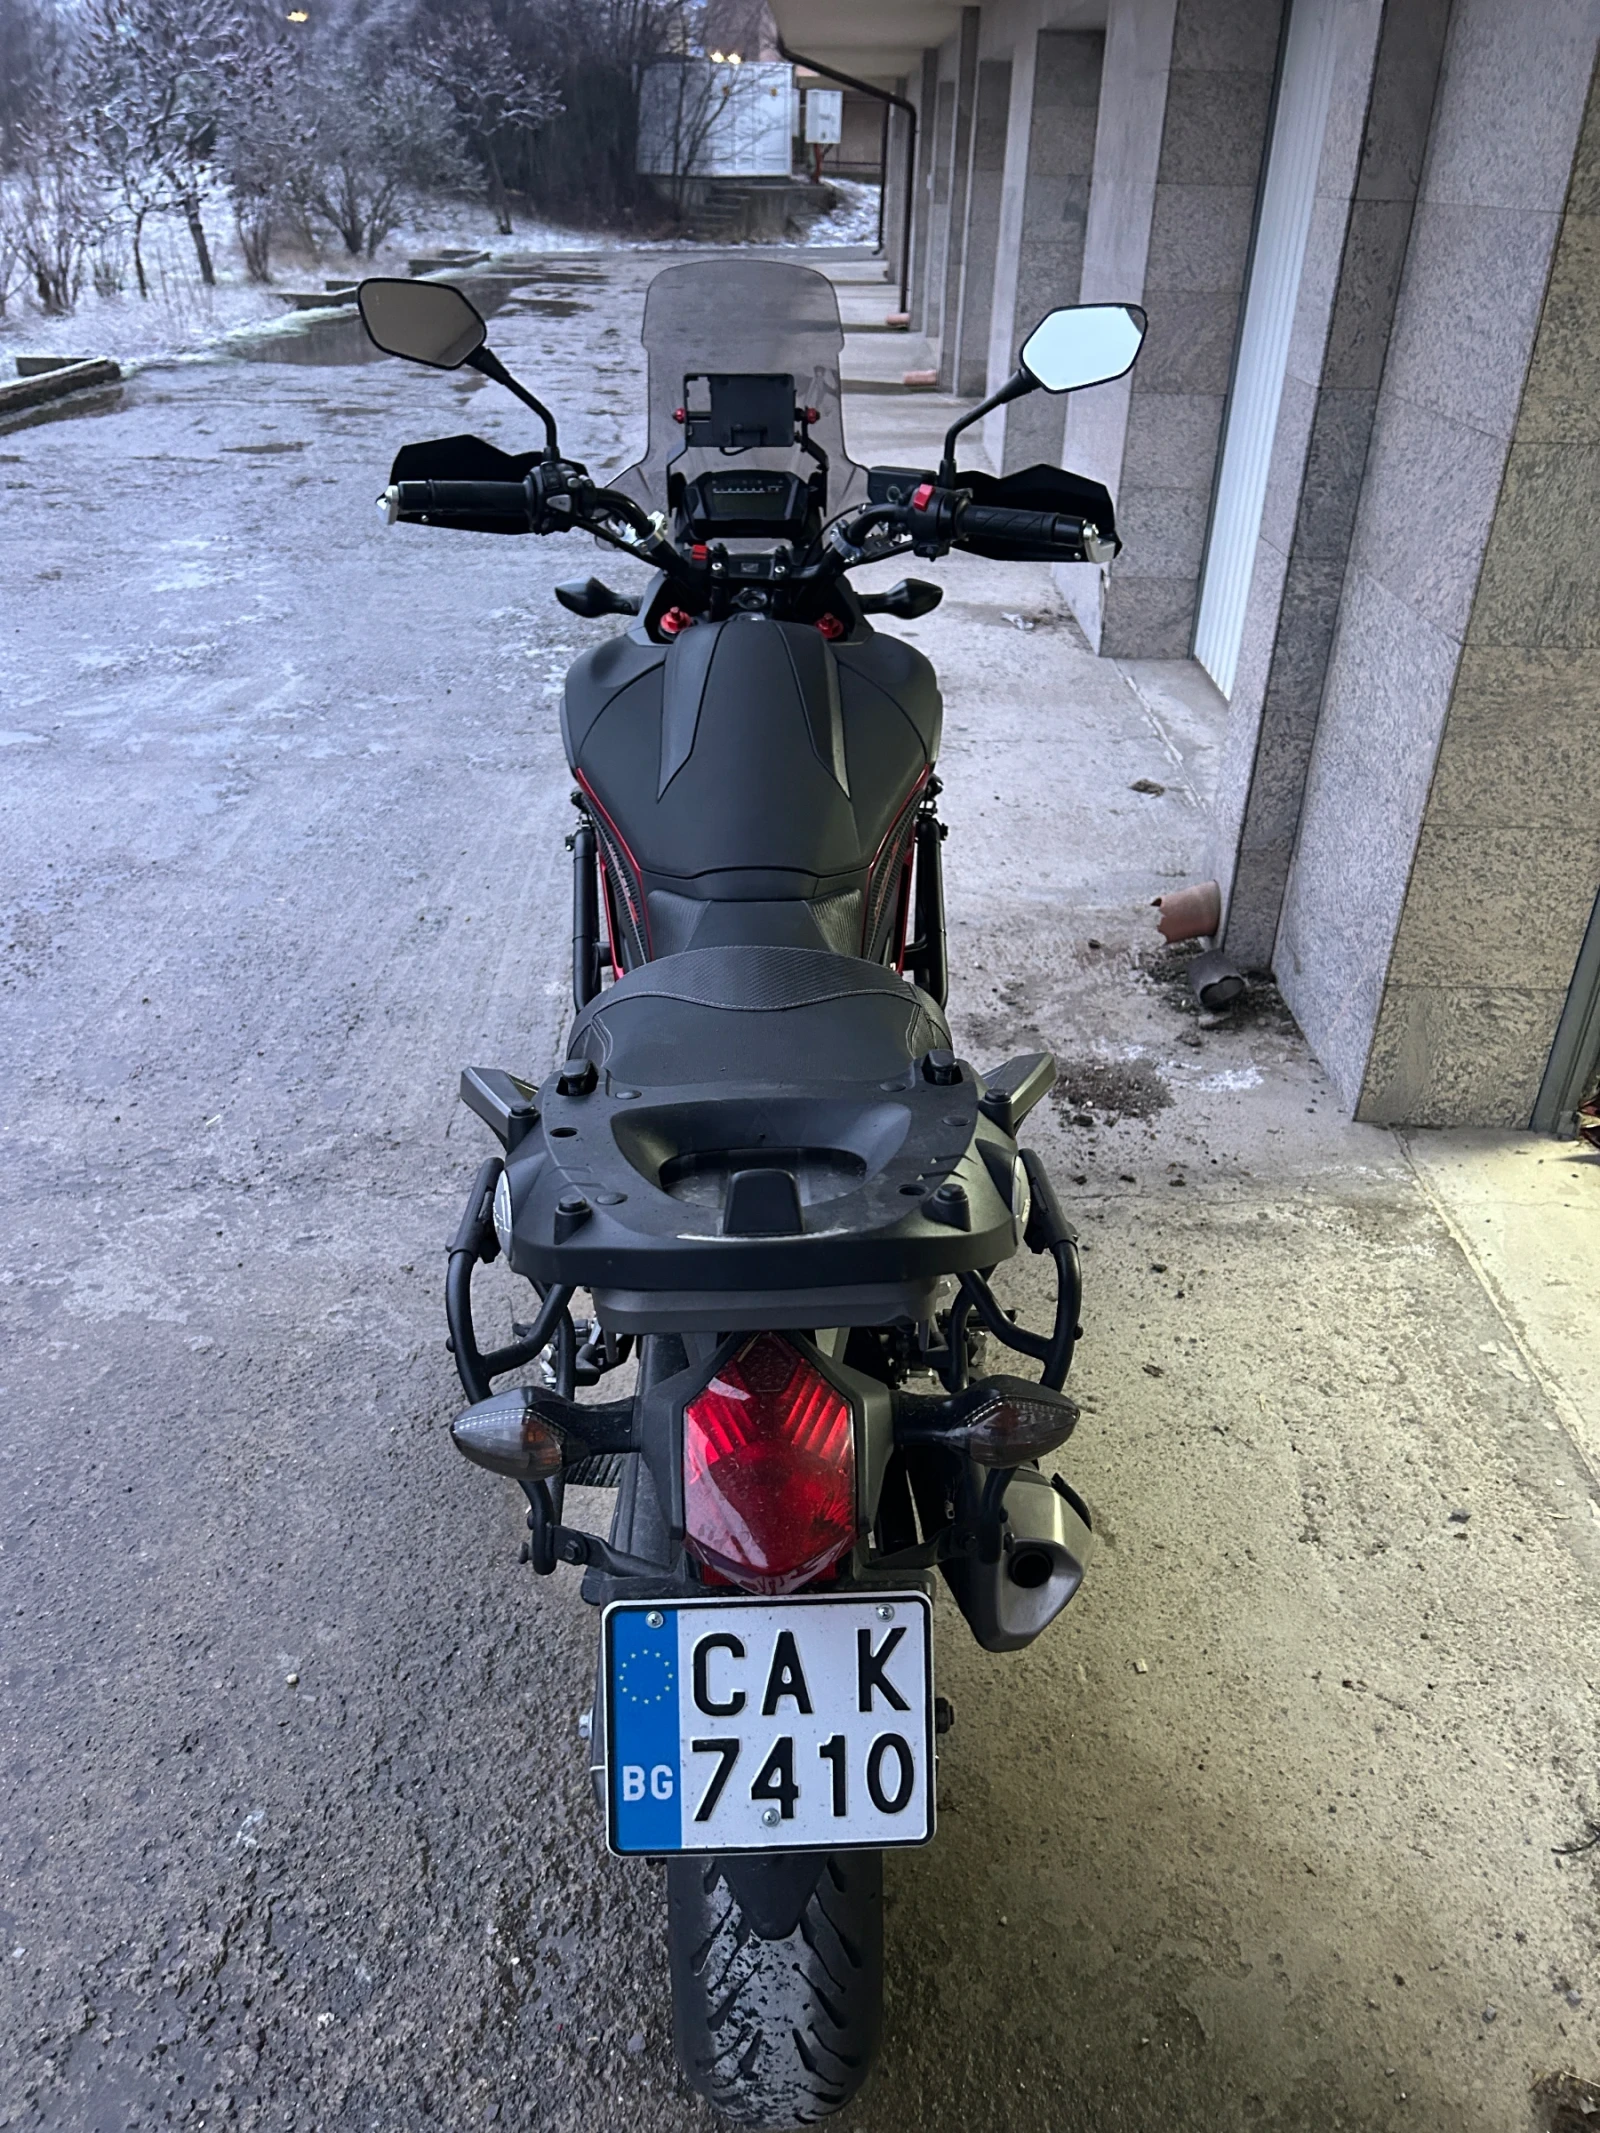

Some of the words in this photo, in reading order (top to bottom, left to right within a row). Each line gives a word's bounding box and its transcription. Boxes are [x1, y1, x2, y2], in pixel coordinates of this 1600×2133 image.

[693, 1631, 814, 1717] CA
[857, 1626, 911, 1713] K
[622, 1765, 674, 1801] BG
[691, 1733, 915, 1822] 7410
